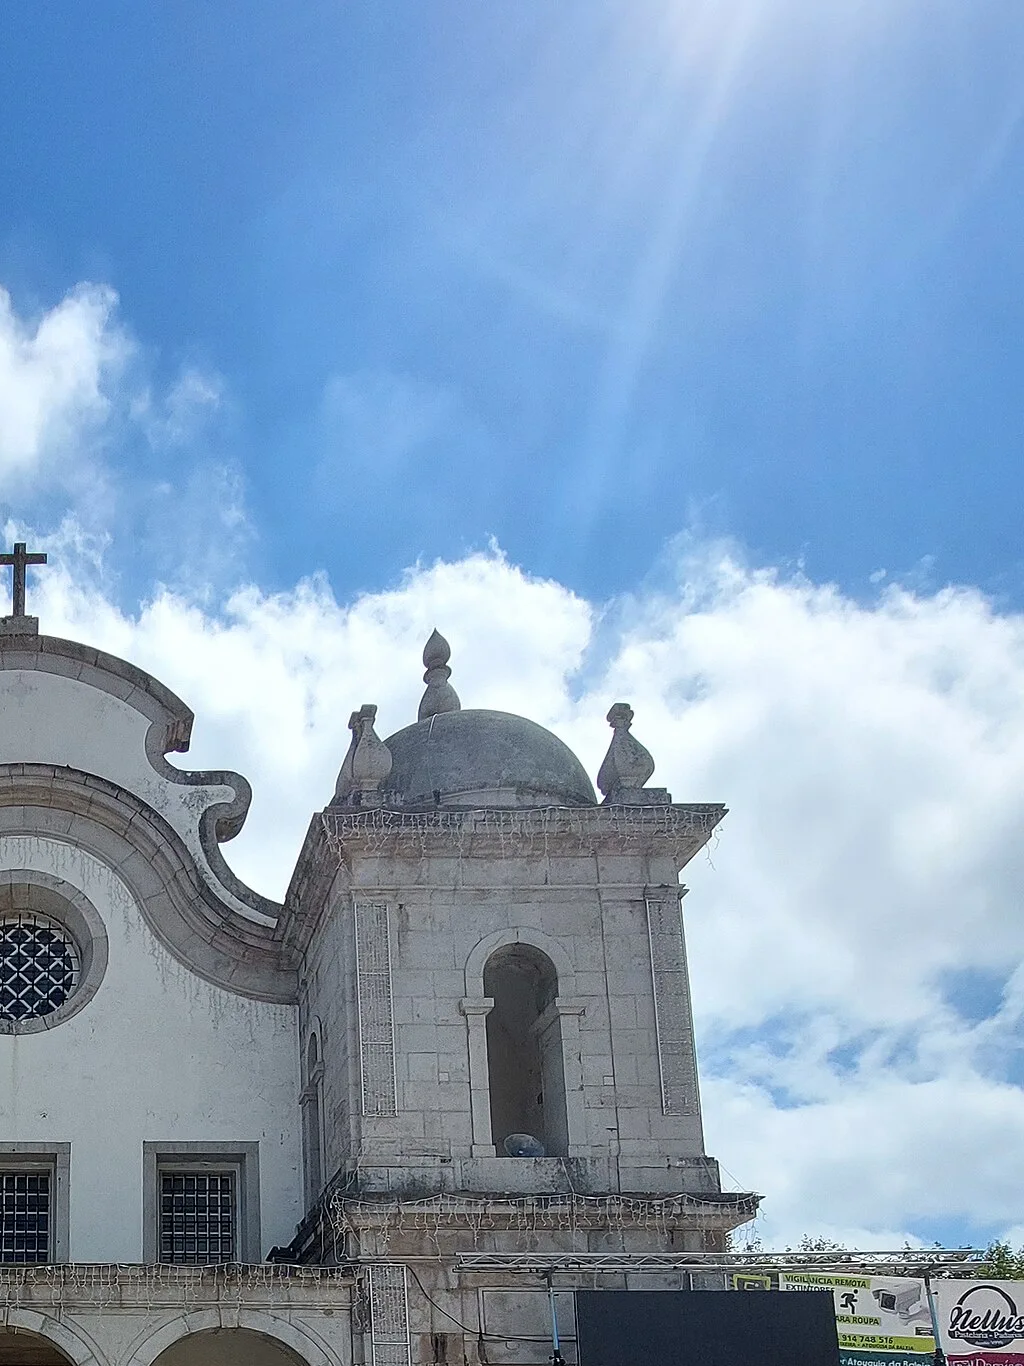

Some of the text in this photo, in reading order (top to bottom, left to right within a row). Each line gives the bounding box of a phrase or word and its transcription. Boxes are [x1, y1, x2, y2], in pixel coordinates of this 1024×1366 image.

[835, 1278, 866, 1288] REMOTA
[836, 1315, 880, 1325] ARA ROUPA
[842, 1334, 857, 1342] 914
[859, 1335, 876, 1343] 748
